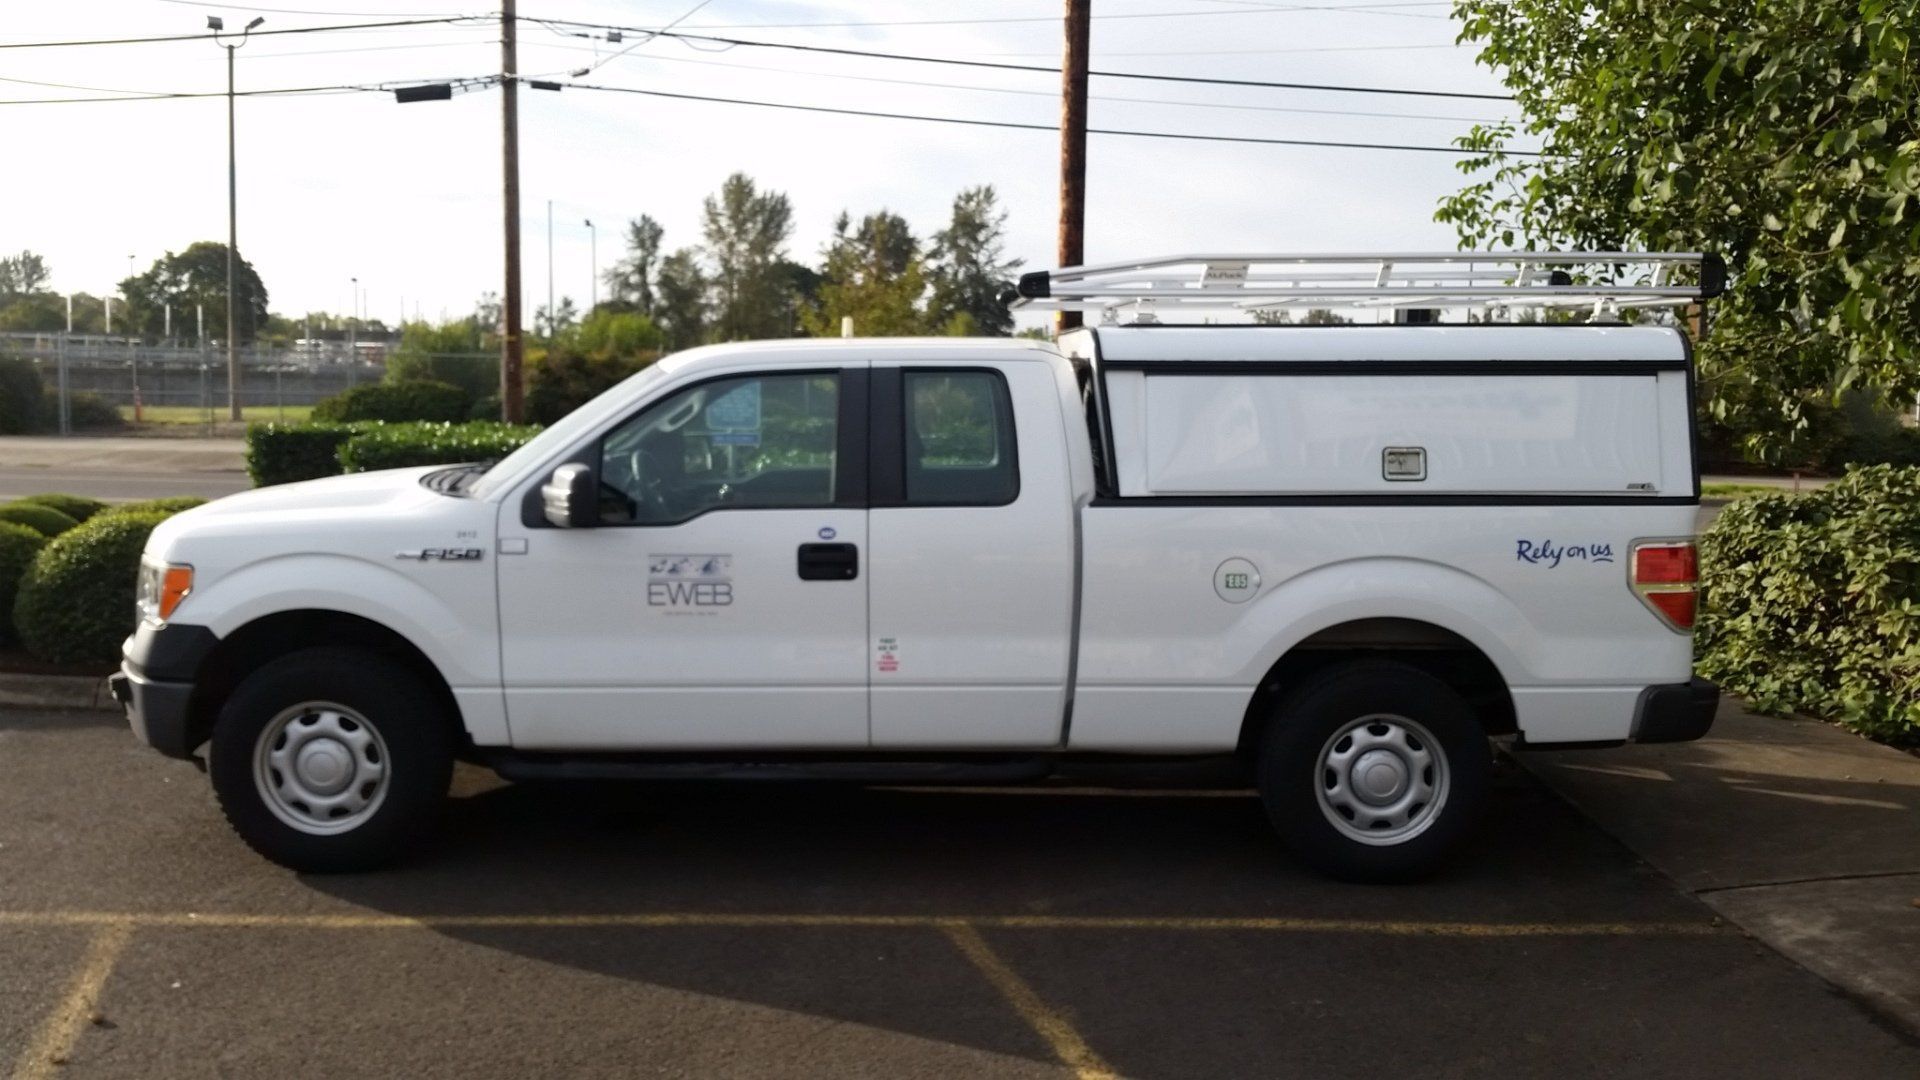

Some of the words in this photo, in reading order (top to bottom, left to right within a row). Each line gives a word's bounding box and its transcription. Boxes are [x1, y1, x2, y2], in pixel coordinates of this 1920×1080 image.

[1517, 540, 1564, 569] Rely
[1566, 546, 1586, 560] on
[647, 582, 734, 606] EWEB
